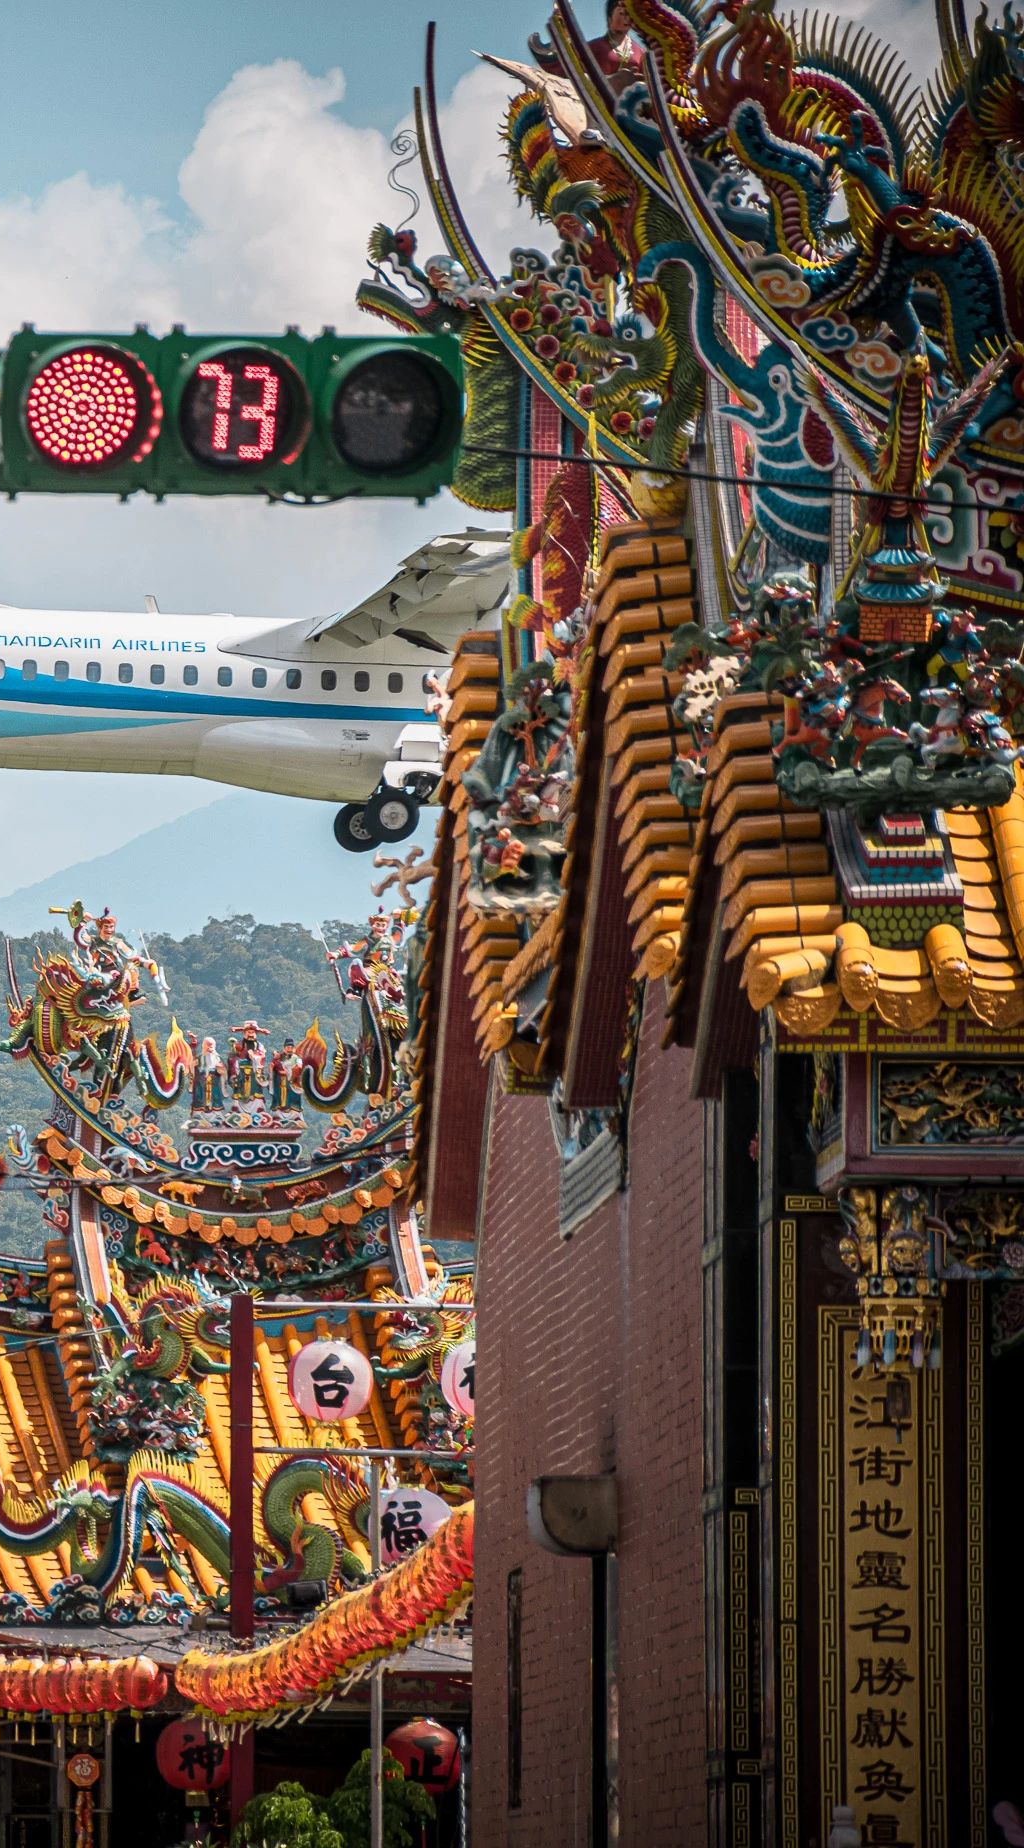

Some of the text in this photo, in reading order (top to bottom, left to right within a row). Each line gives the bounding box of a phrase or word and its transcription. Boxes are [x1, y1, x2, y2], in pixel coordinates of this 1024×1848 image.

[198, 362, 279, 461] 73
[111, 638, 206, 653] AIRLINES
[310, 1352, 356, 1409] 台
[380, 1500, 429, 1553] 福
[178, 1733, 225, 1785] 神
[404, 1735, 449, 1785] 正
